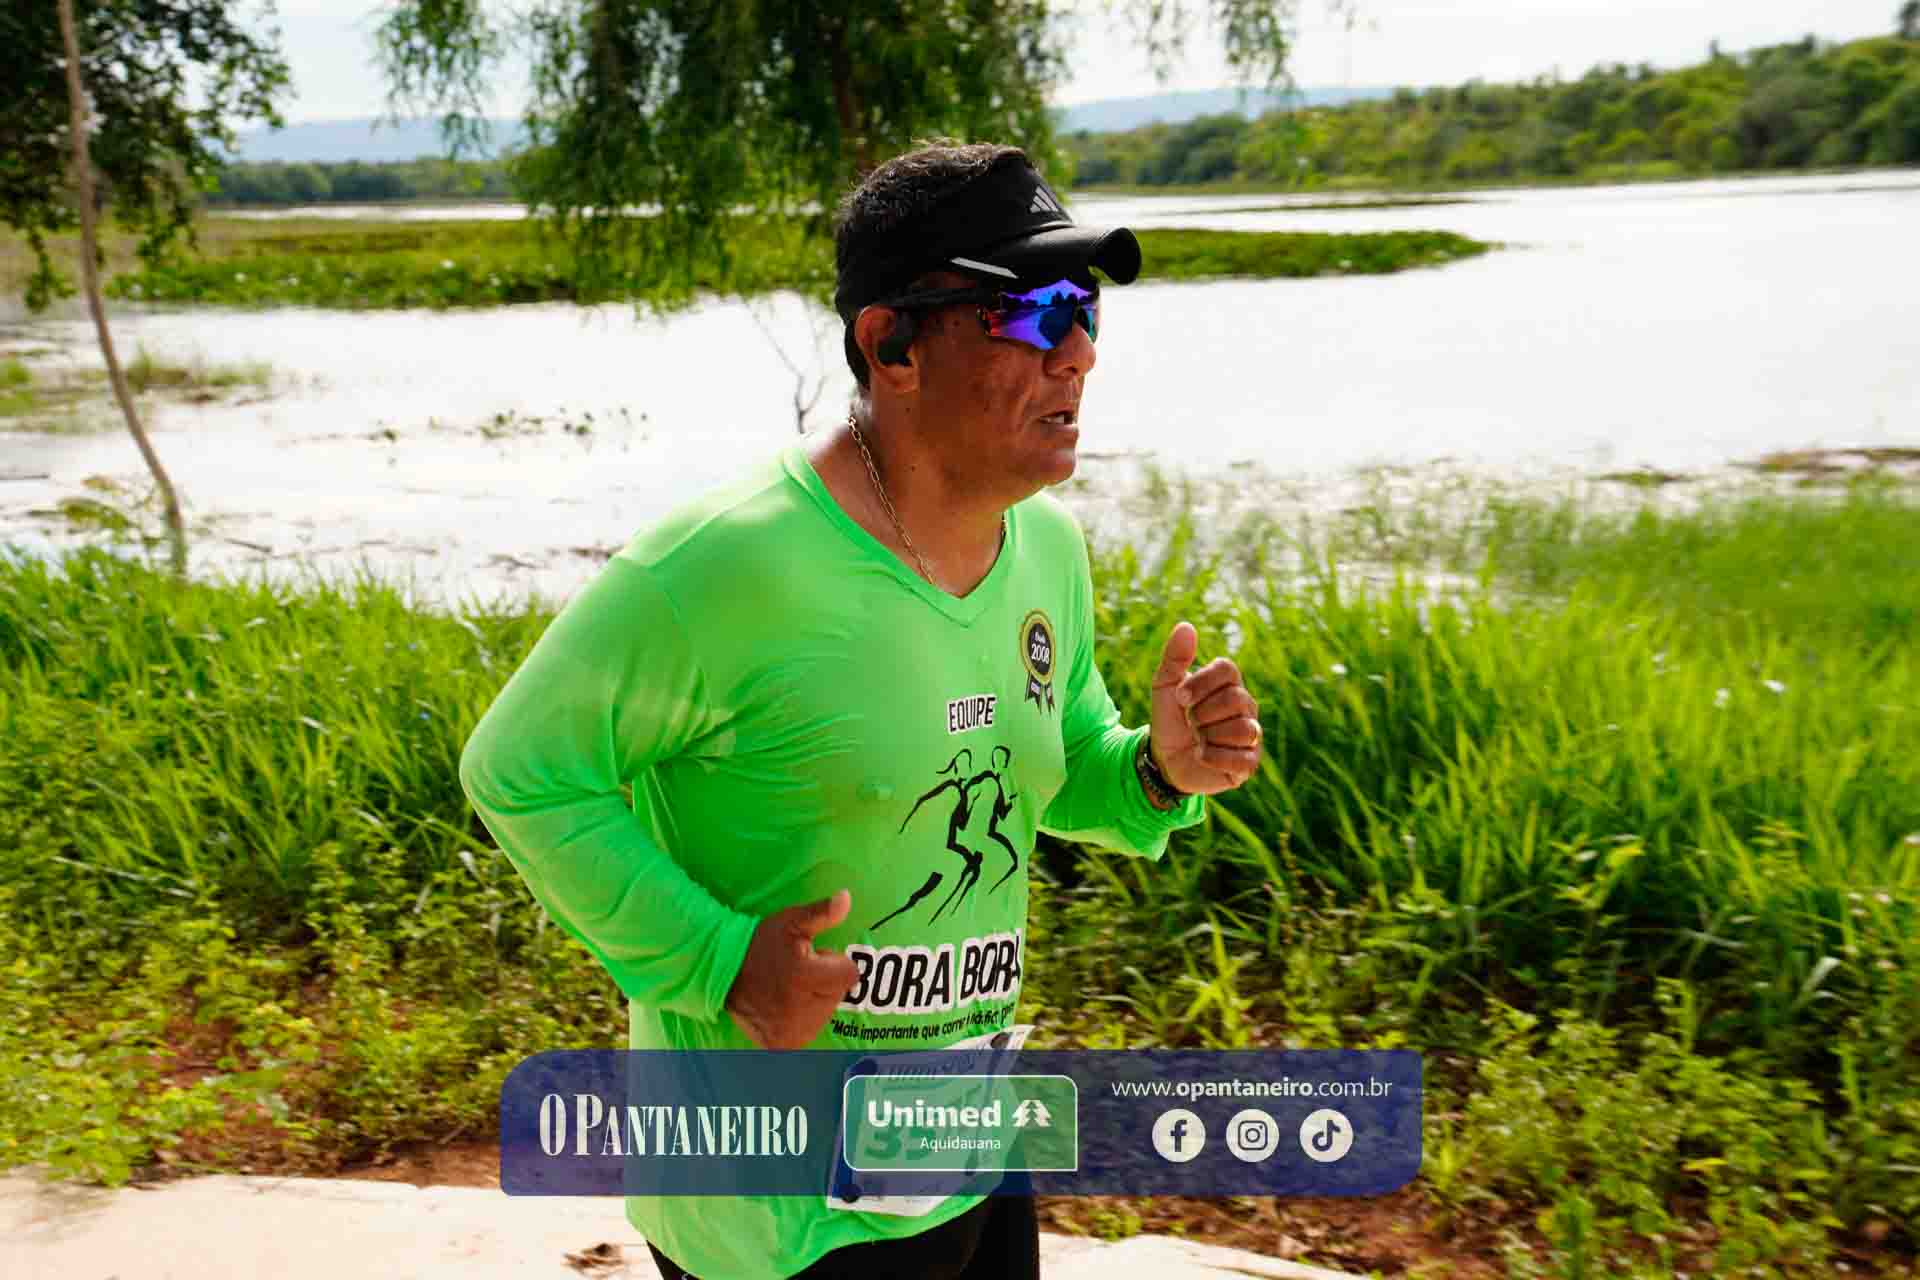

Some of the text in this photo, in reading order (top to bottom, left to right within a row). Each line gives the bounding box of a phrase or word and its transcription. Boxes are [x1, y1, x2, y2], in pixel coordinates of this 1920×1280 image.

[1031, 643, 1050, 665] 2008
[948, 697, 996, 732] EQUIPE
[843, 935, 1021, 1008] BORA BORA
[860, 1024, 919, 1044] importante
[921, 1023, 940, 1041] que
